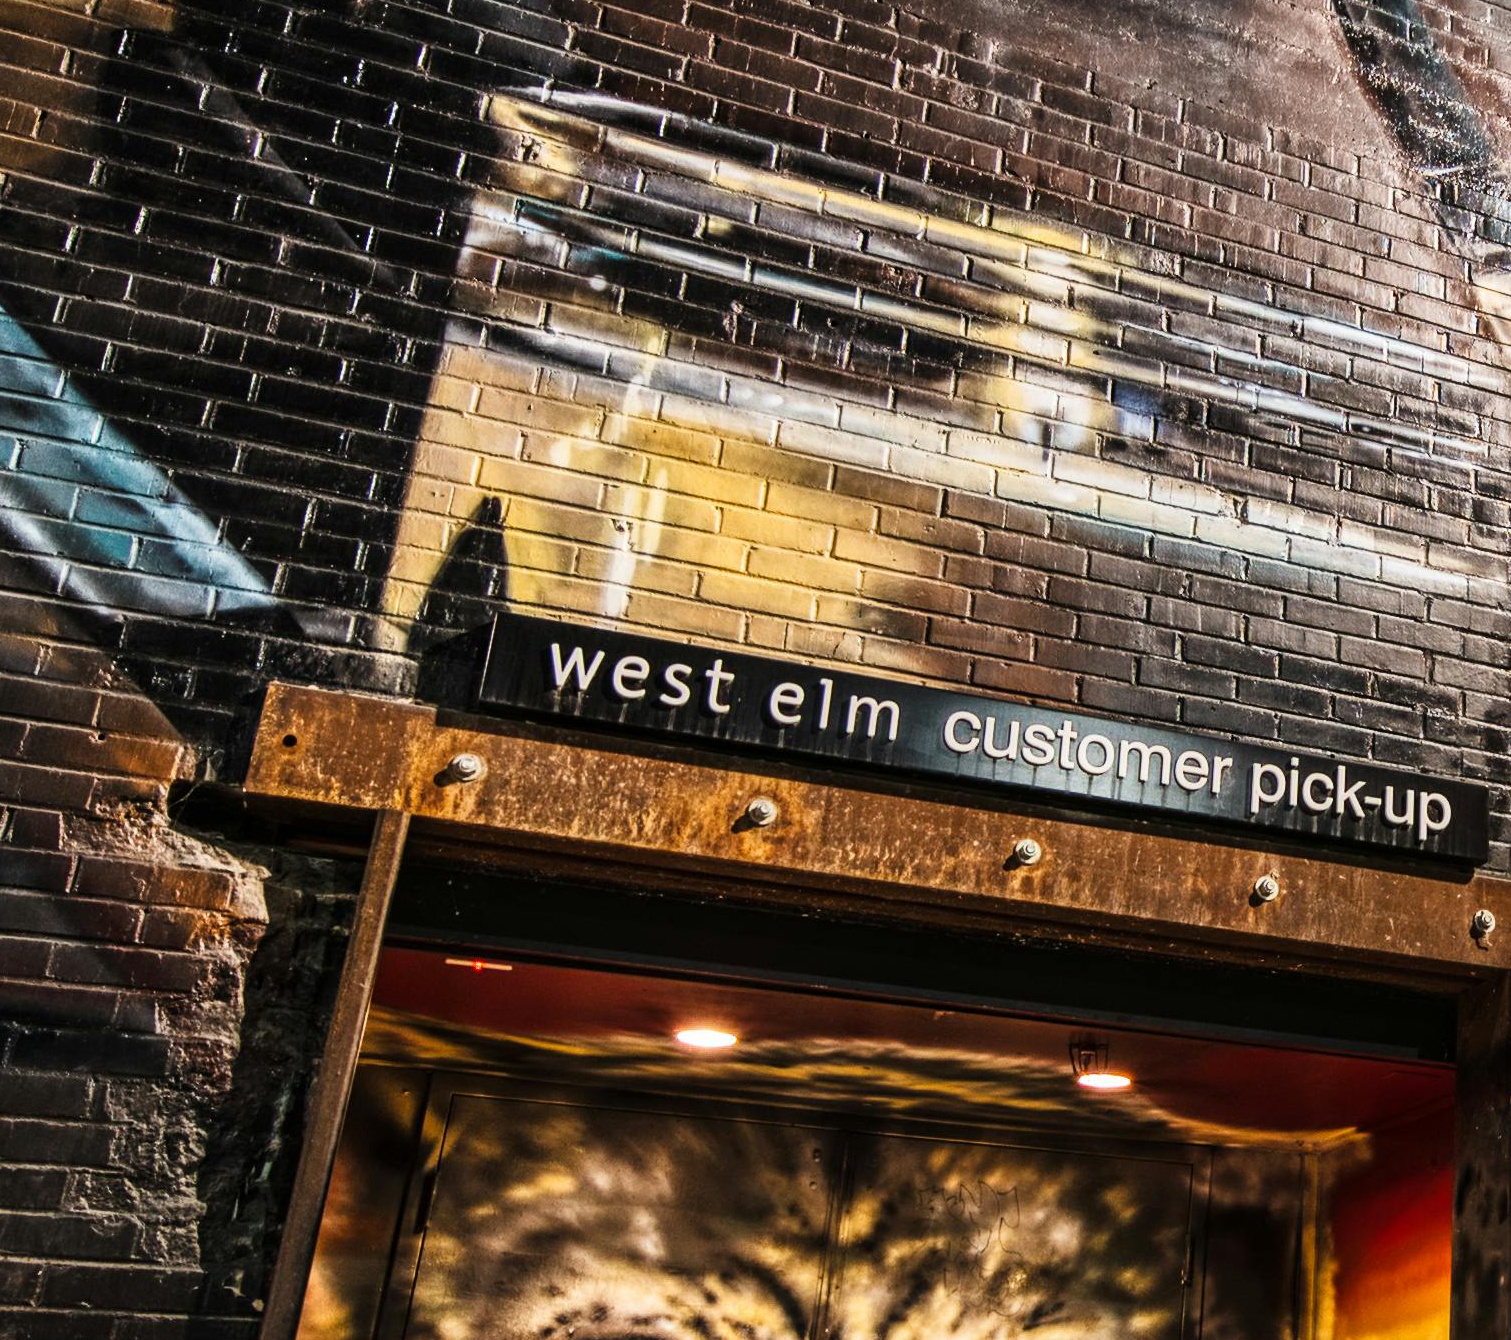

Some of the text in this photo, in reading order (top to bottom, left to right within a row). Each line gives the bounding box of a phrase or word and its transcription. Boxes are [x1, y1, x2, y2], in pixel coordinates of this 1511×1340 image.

[548, 640, 1455, 842] west elm customer pick-up
